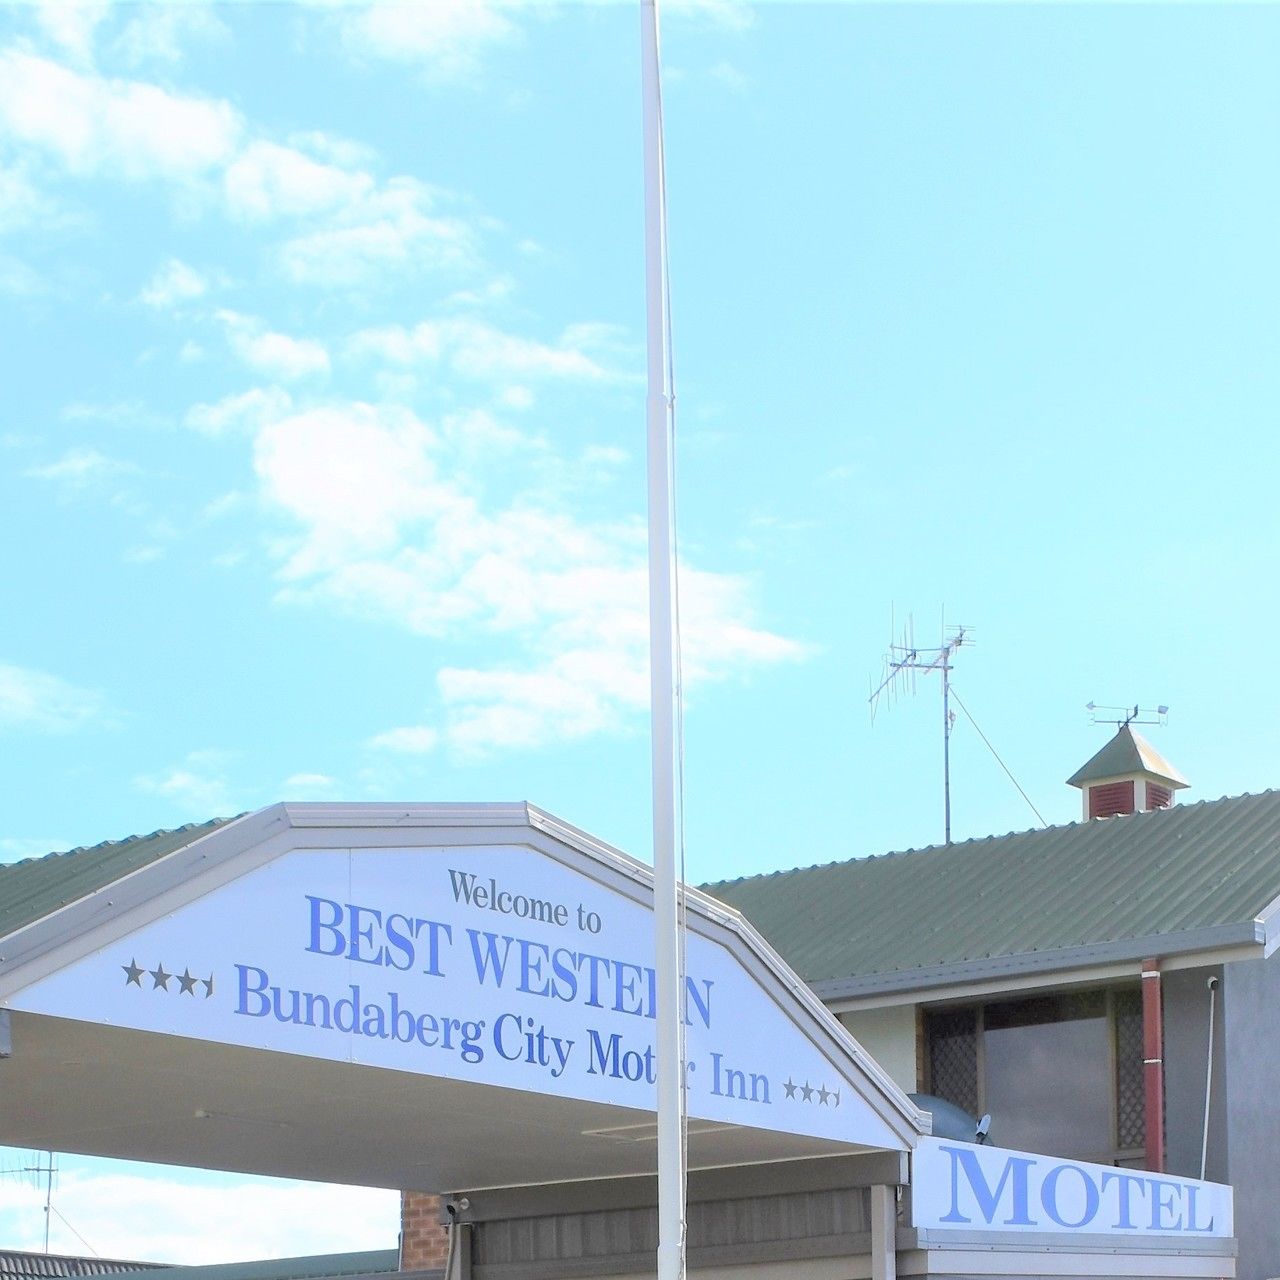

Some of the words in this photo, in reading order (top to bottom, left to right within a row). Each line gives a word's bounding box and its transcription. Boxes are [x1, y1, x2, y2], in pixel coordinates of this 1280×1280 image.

[304, 894, 453, 978] BEST
[447, 868, 568, 927] Welcome
[576, 903, 602, 934] to
[233, 963, 486, 1064] Bundaberg
[493, 1013, 575, 1078] City
[586, 1028, 696, 1091] Motr
[709, 1052, 772, 1104] Inn
[938, 1145, 1214, 1233] MOTEL
